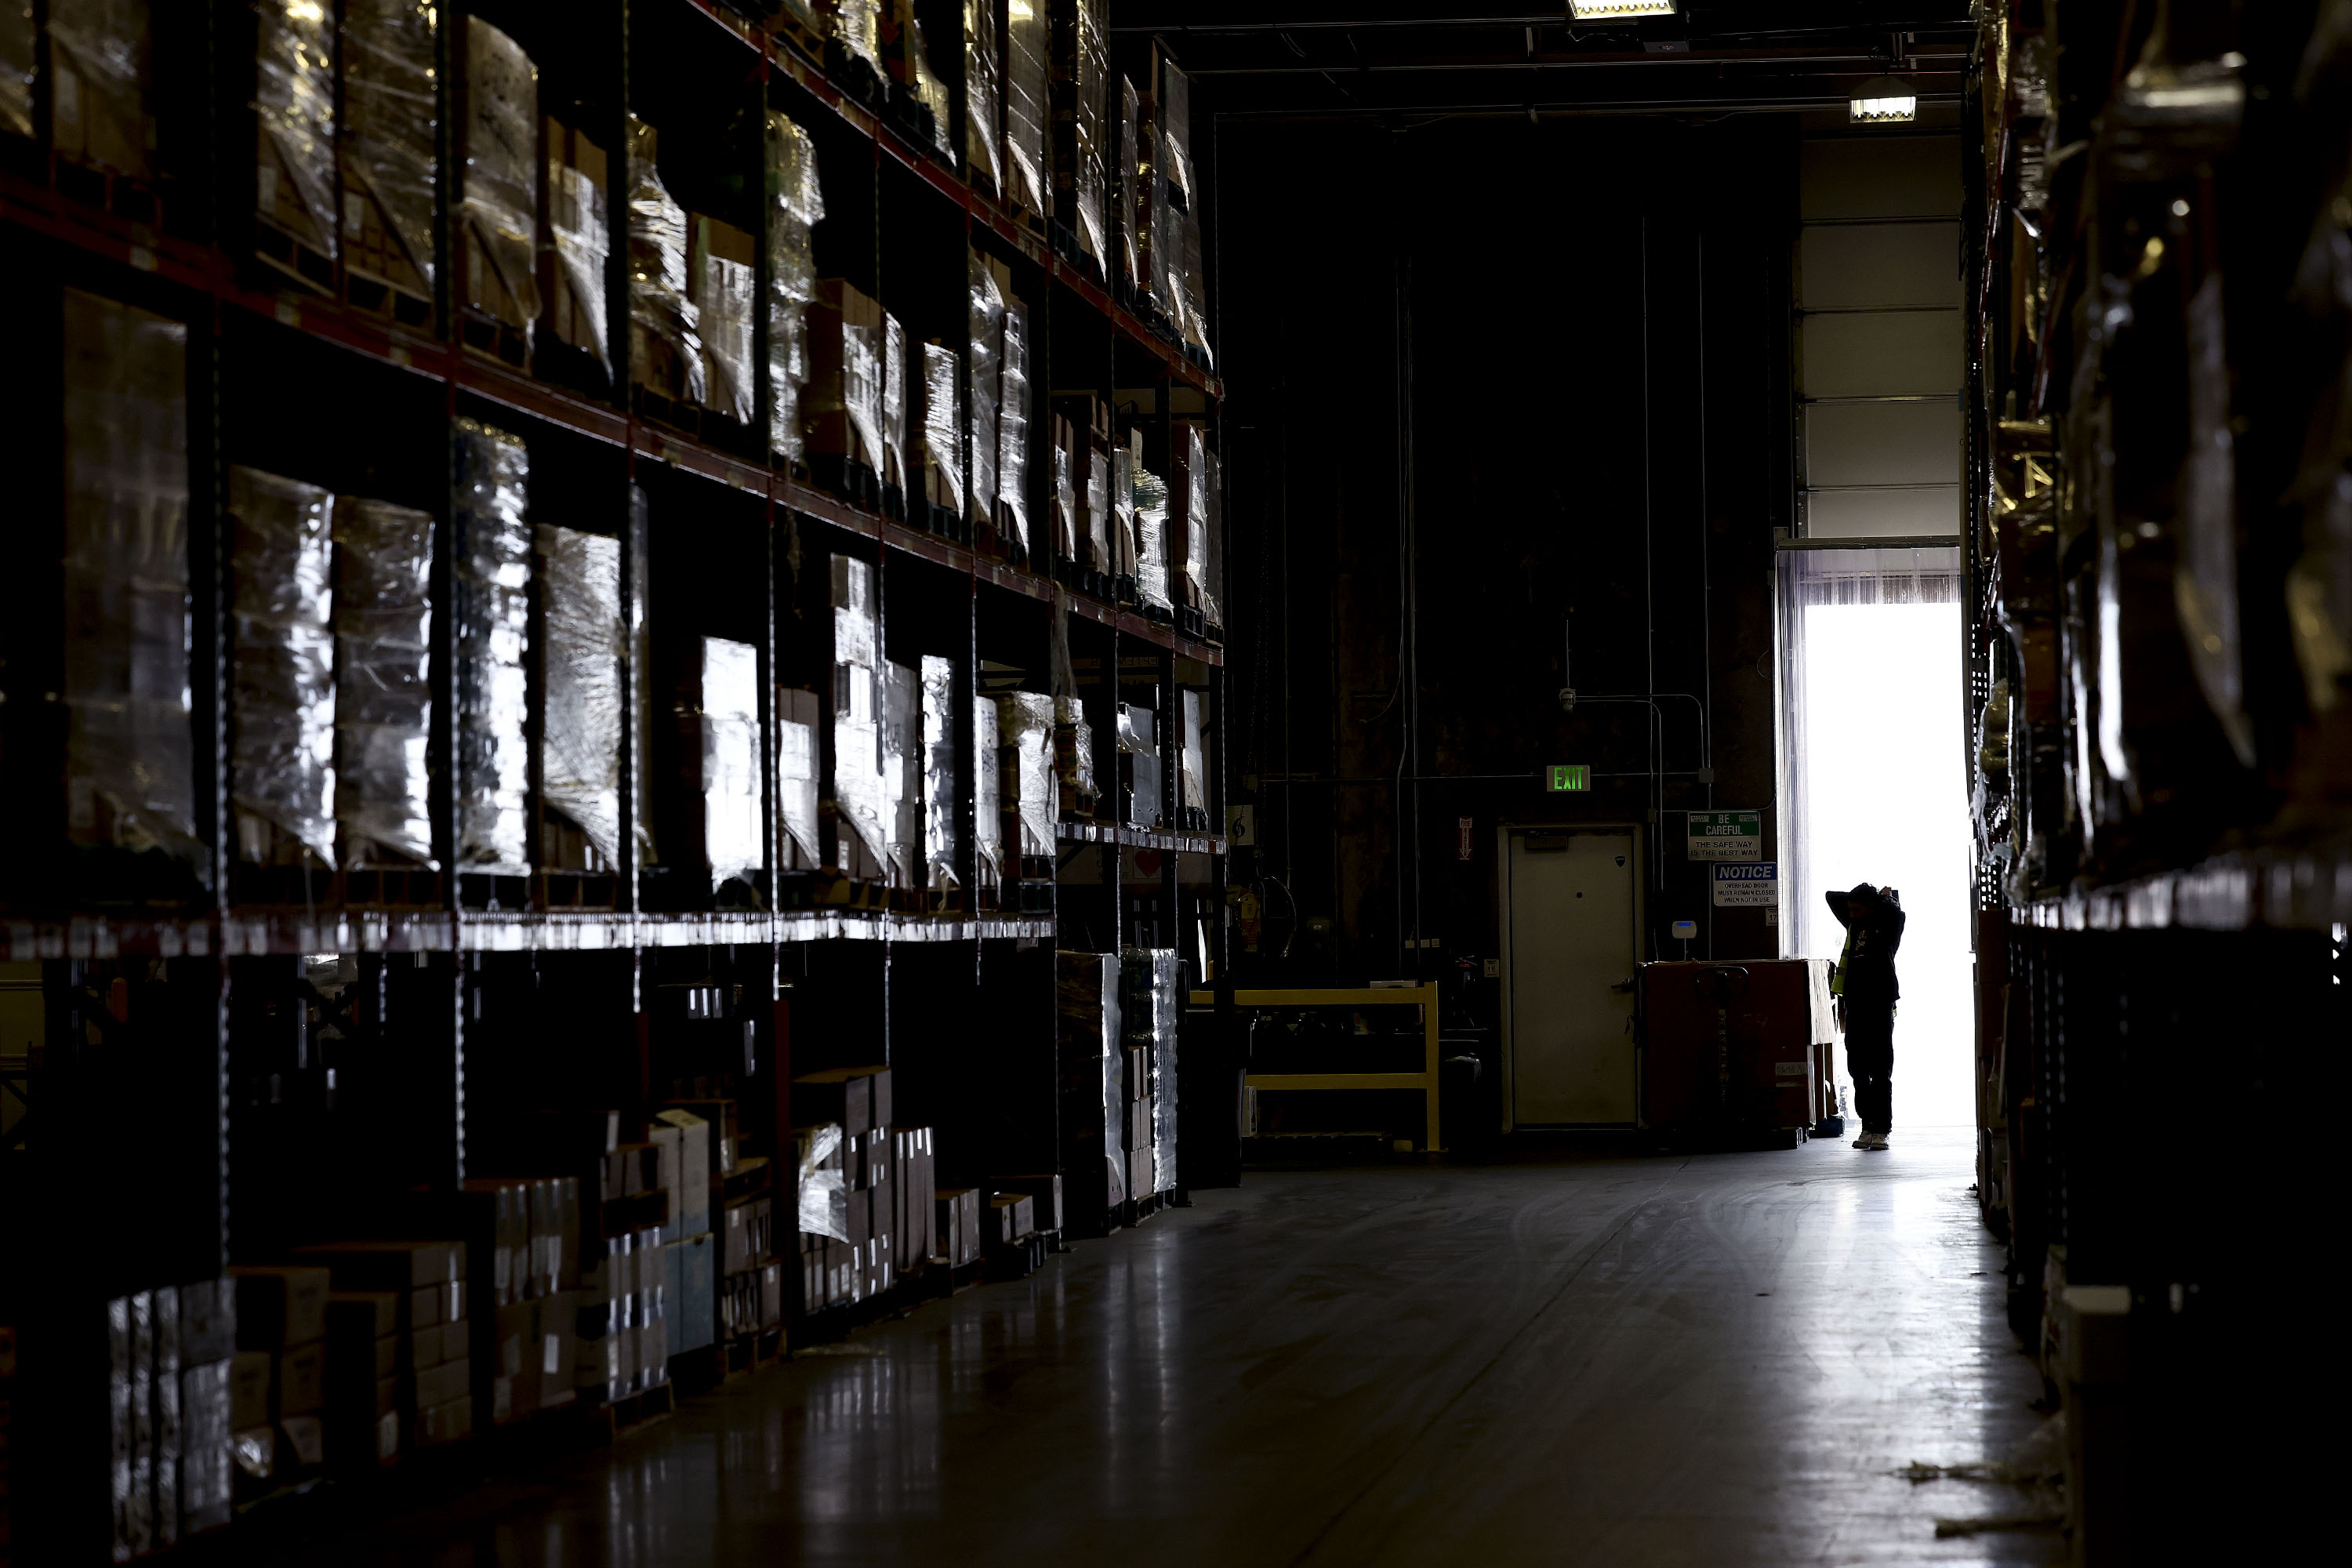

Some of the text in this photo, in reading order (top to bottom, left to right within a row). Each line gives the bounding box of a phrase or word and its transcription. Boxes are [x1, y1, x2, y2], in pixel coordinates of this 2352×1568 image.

[1555, 767, 1584, 789] EXIT
[1719, 815, 1730, 823] BE
[1706, 826, 1743, 835] CAREFUL
[1719, 866, 1772, 878] NOTICE
